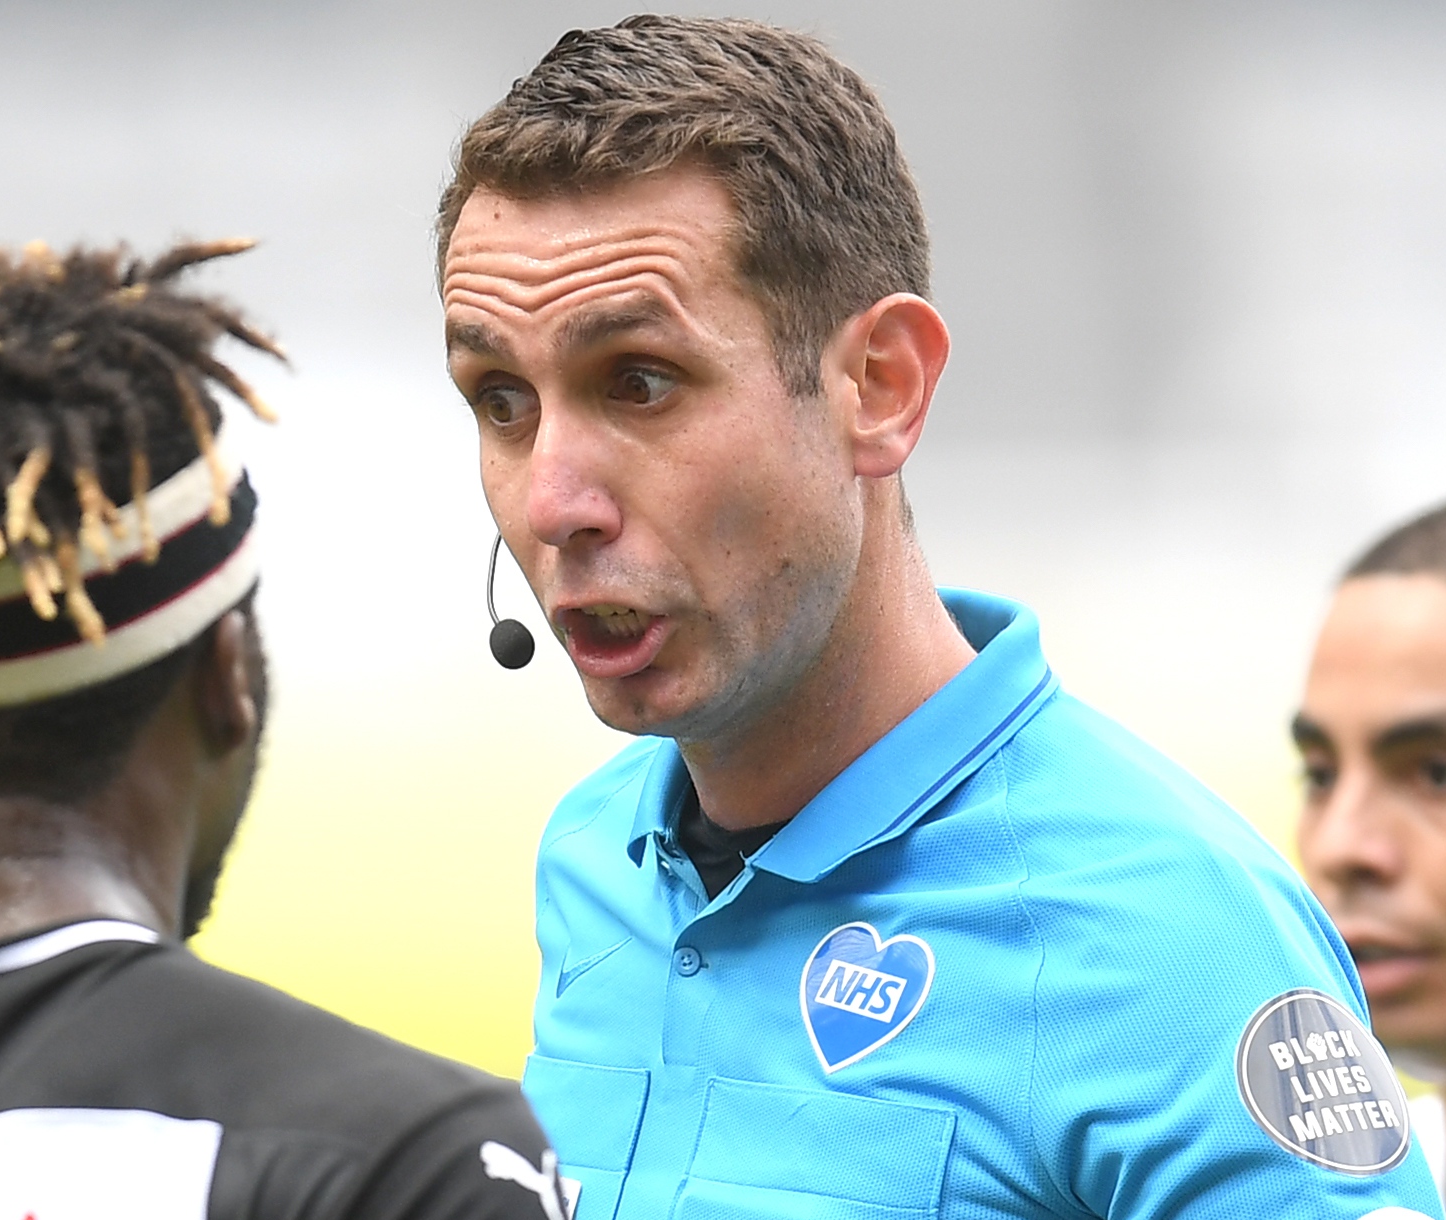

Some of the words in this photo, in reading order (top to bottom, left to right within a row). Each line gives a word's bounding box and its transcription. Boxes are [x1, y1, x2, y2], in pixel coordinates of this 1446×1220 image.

[819, 965, 902, 1015] NHS
[1290, 1065, 1372, 1104] LIVES
[1288, 1099, 1401, 1143] MATTER
